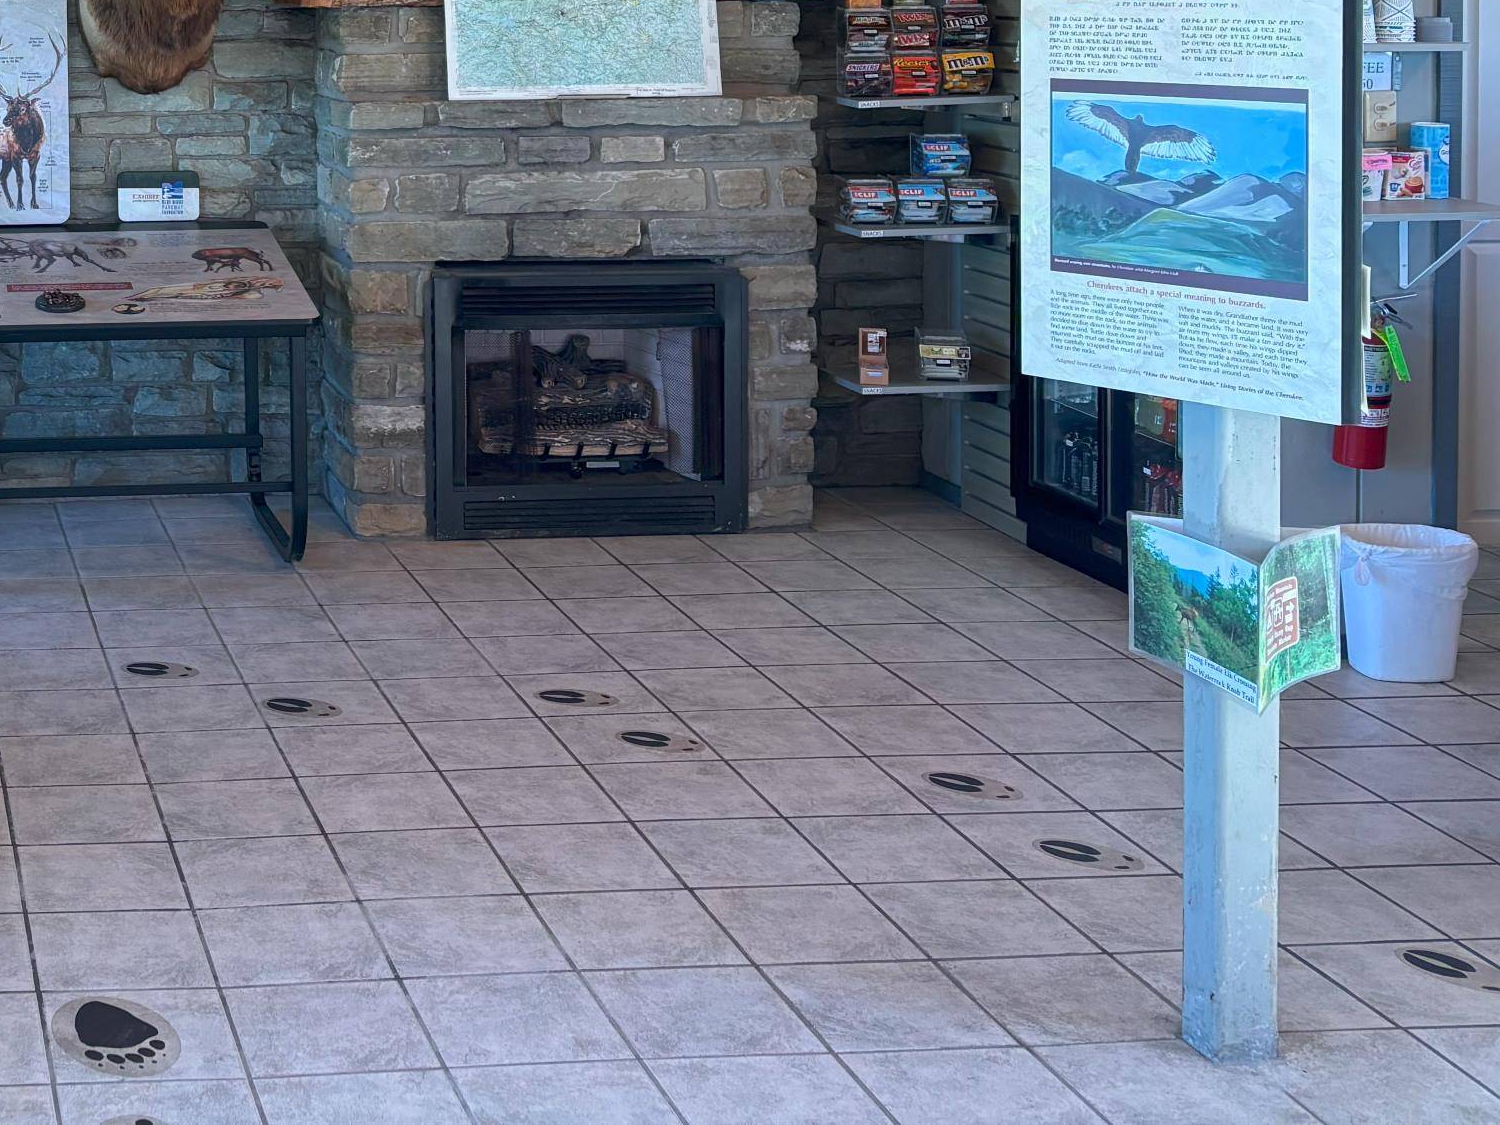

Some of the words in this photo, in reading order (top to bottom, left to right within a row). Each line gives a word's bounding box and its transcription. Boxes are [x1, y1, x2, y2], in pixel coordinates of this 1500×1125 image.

[1087, 280, 1123, 291] Cherokees
[1125, 286, 1148, 295] attach
[1156, 290, 1181, 299] special
[1184, 294, 1216, 304] meaning
[1228, 297, 1266, 309] buzzards.
[1201, 316, 1216, 324] water,
[1237, 321, 1259, 329] became
[1226, 312, 1258, 322] Grandfather
[1197, 344, 1209, 352] they
[1295, 356, 1307, 364] they
[1278, 346, 1298, 355] dipped
[1170, 375, 1186, 383] World
[1220, 382, 1236, 391] Living
[1238, 385, 1256, 394] Stories
[1187, 652, 1204, 665] Young
[1205, 659, 1223, 674] Female
[1224, 669, 1232, 679] Elk
[1234, 675, 1256, 693] Crossing
[1188, 664, 1197, 672] The
[1242, 691, 1254, 703] Trail
